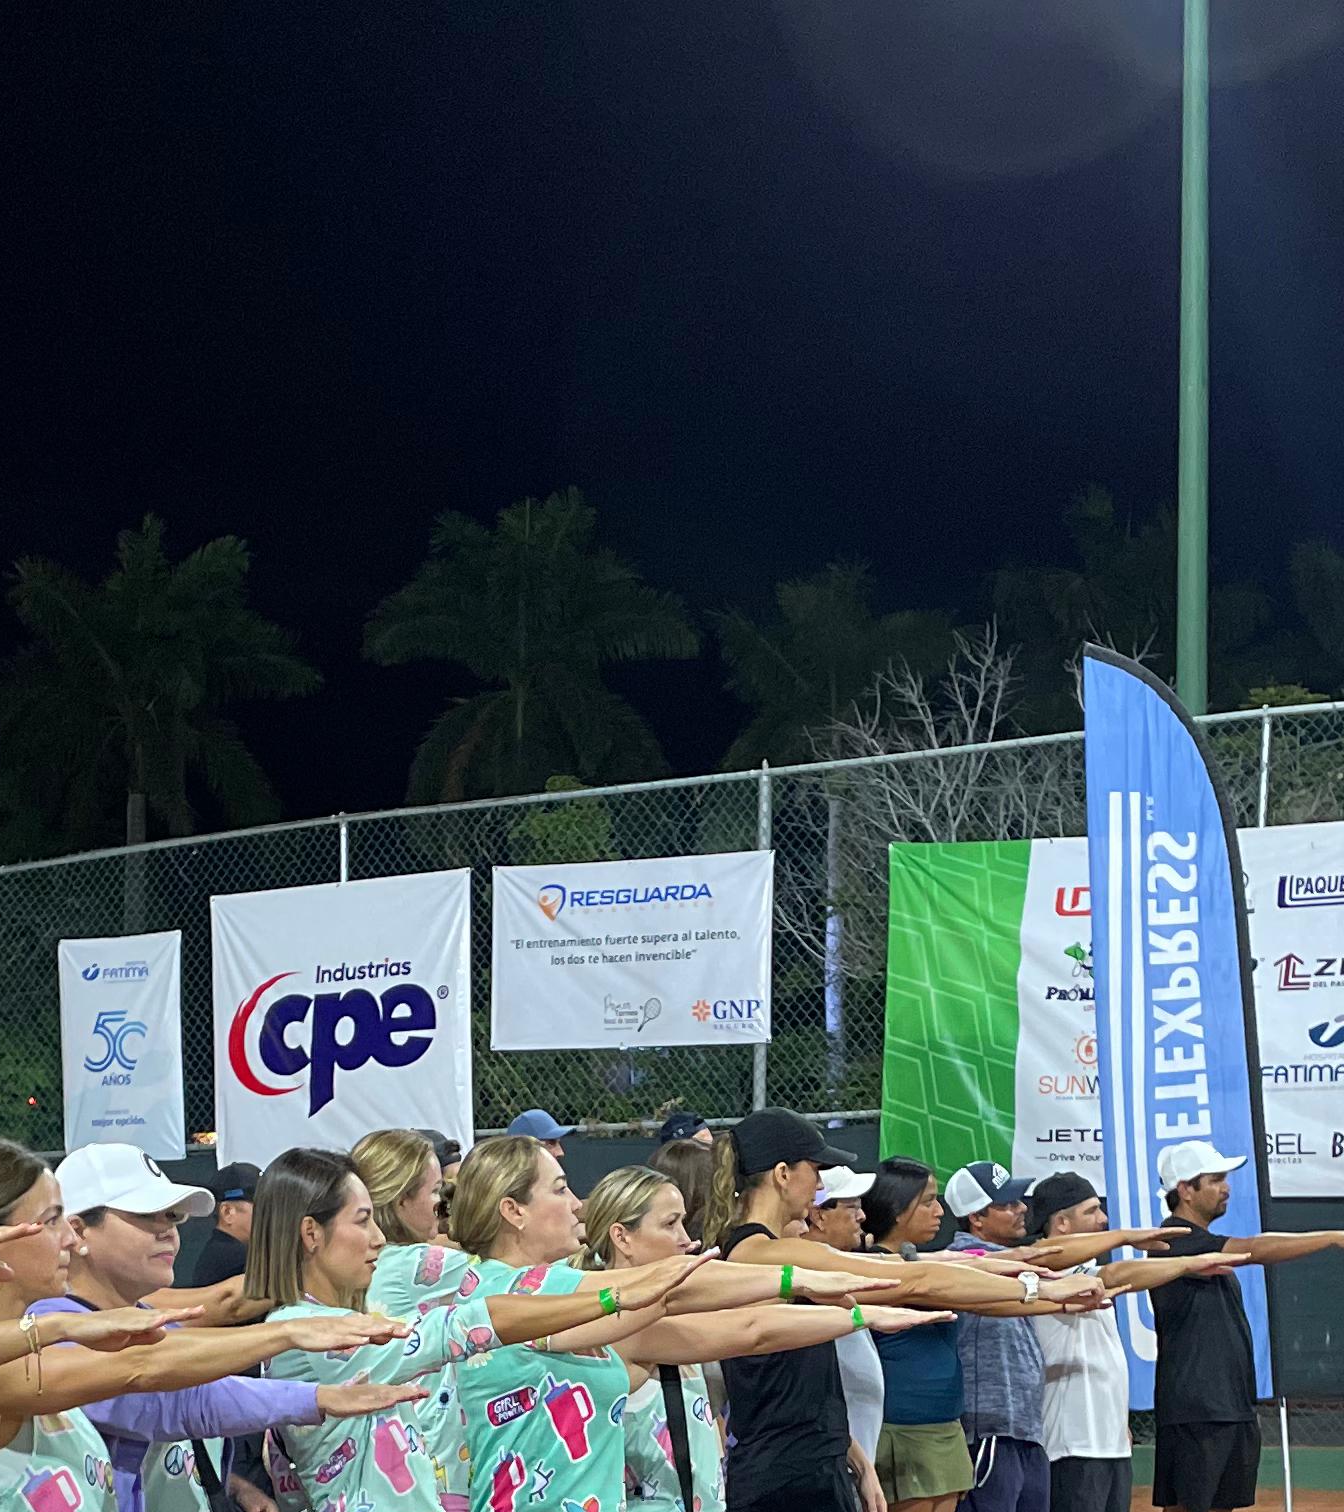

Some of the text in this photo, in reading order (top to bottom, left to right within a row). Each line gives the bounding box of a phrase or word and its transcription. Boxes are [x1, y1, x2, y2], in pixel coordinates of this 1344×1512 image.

[570, 883, 713, 908] RESGUARDA
[526, 937, 603, 949] entrenamiento
[605, 934, 639, 946] fuerte
[641, 934, 679, 946] supera
[681, 930, 692, 942] al
[551, 954, 566, 966] los
[568, 953, 585, 965] dos
[588, 954, 600, 964] te
[602, 952, 633, 964] hacen
[103, 966, 150, 979] FATIMA
[315, 957, 412, 984] Industrias
[713, 1000, 760, 1020] GNP
[258, 983, 437, 1118] cpe
[101, 1072, 133, 1087] AÑOS
[1049, 1152, 1102, 1162] Drive Your
[494, 1396, 520, 1414] GIRL
